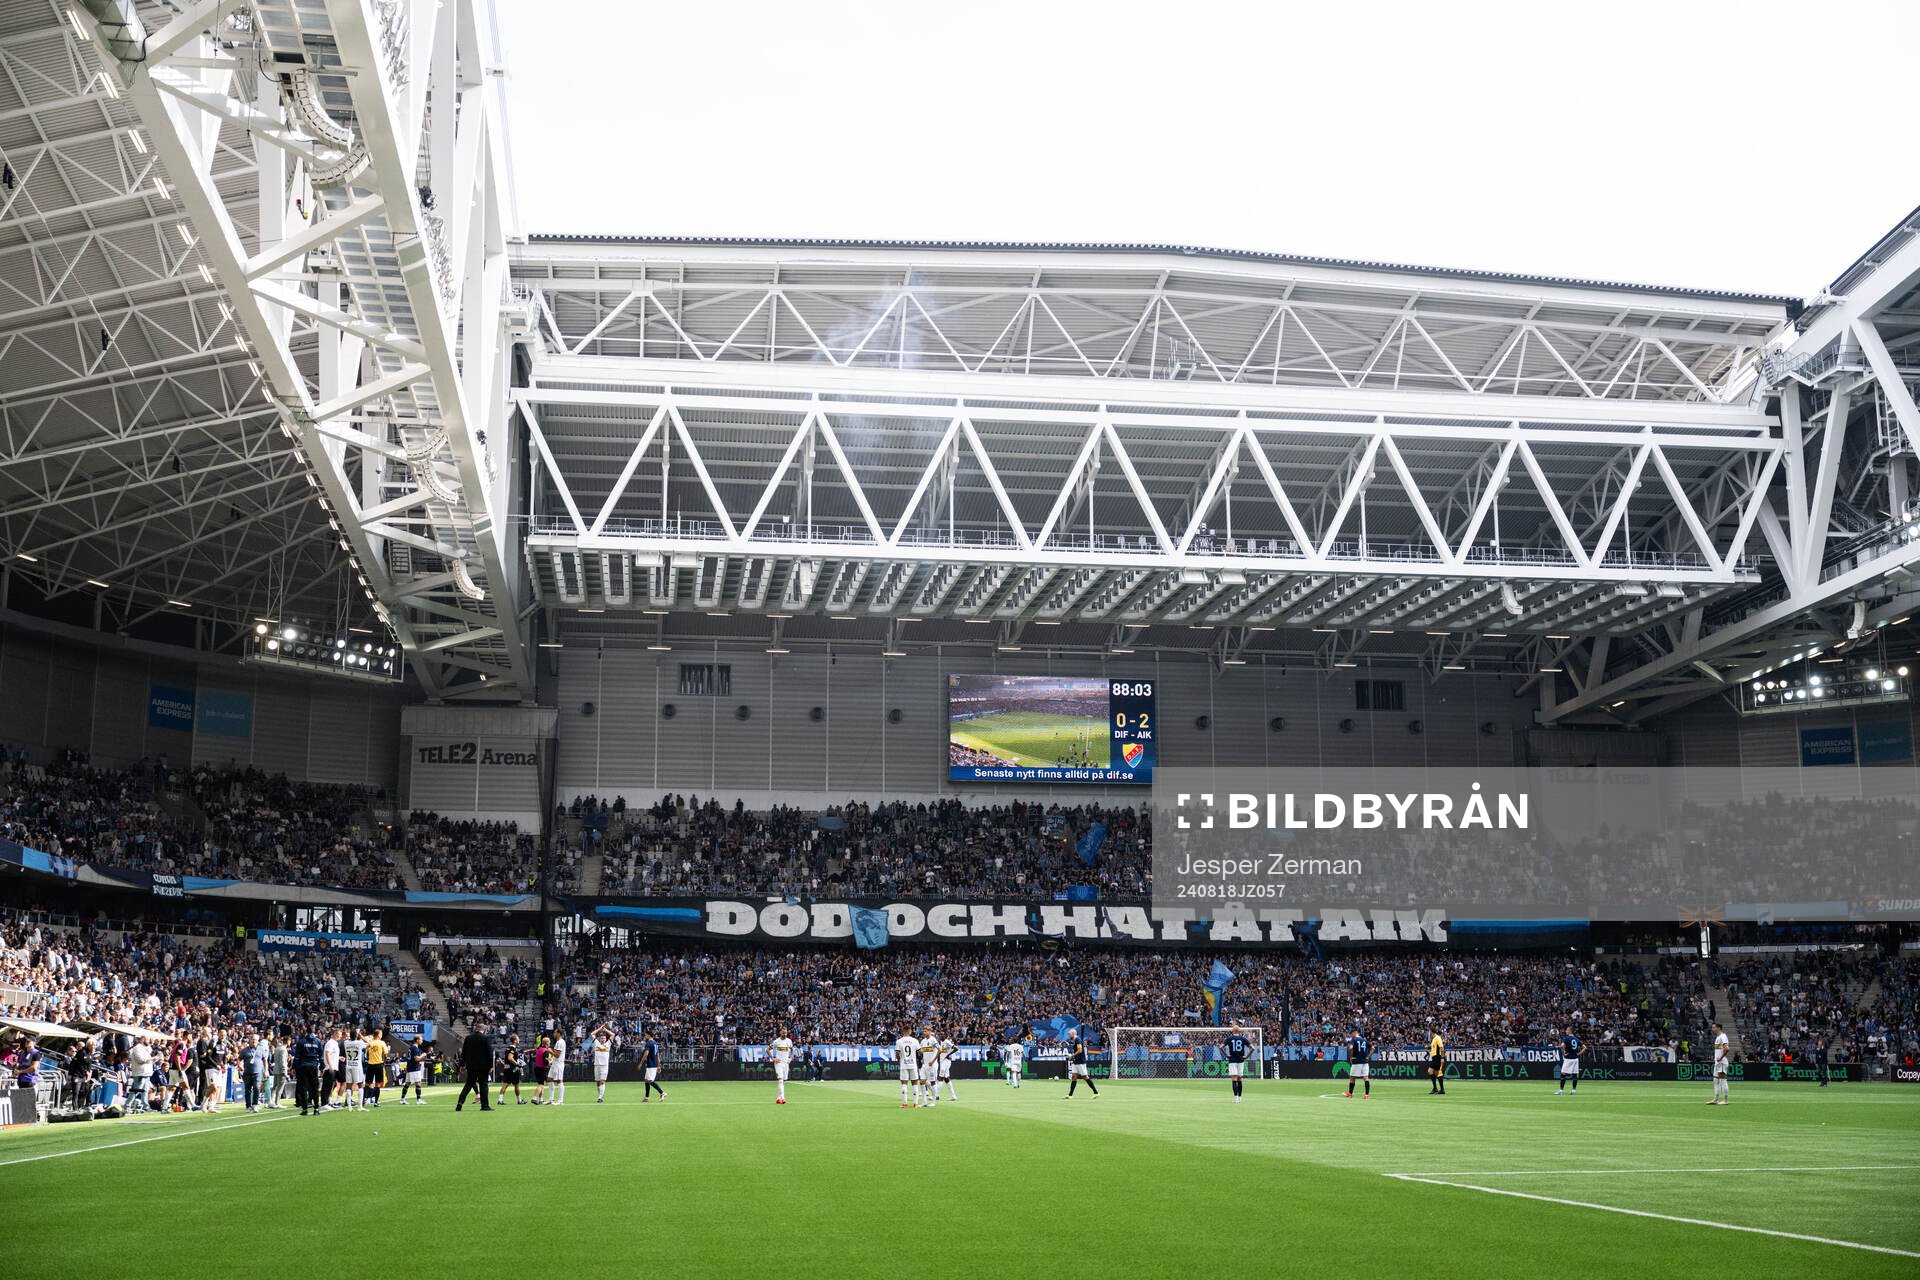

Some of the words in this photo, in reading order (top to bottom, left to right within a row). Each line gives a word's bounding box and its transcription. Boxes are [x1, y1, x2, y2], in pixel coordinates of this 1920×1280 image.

[1112, 683, 1152, 697] 88:03
[152, 698, 193, 712] AMERICAN
[156, 706, 193, 719] EXPRESS
[1116, 712, 1127, 728] 0
[1139, 713, 1149, 728] 2
[1114, 730, 1128, 739] DIF
[1136, 731, 1152, 739] AIK
[1804, 739, 1852, 748] AMERICAN
[418, 742, 477, 765] TELE2
[481, 748, 538, 766] Arena
[1810, 746, 1852, 755] EXPRESS
[975, 768, 1013, 778] Senaste
[1016, 769, 1034, 780] nytt
[1037, 769, 1062, 779] finns
[1065, 769, 1089, 779] alltid
[1092, 769, 1104, 781] på
[1107, 770, 1133, 780] dif.se
[706, 896, 854, 938] DÖD
[879, 902, 1028, 938] OCH
[1040, 904, 1196, 941] HAT
[1209, 901, 1304, 942] ÅT
[1318, 908, 1448, 943] AIK
[262, 934, 315, 947] APORNAS
[330, 938, 374, 949] PLANET
[391, 1024, 418, 1033] PBERGET
[1231, 1039, 1242, 1052] 18
[1357, 1040, 1367, 1051] 14
[1571, 1039, 1578, 1050] 9
[346, 1050, 359, 1062] 32
[904, 1045, 911, 1058] 9
[1013, 1048, 1020, 1057] 16
[1528, 1050, 1560, 1062] OASEN
[660, 1062, 704, 1070] CKHOLMS
[981, 1061, 1037, 1077] TL
[1369, 1064, 1417, 1077] ordVPN
[1466, 1064, 1529, 1078] ELEDA
[1694, 1063, 1745, 1076] PROB
[1570, 1068, 1616, 1080] TARK
